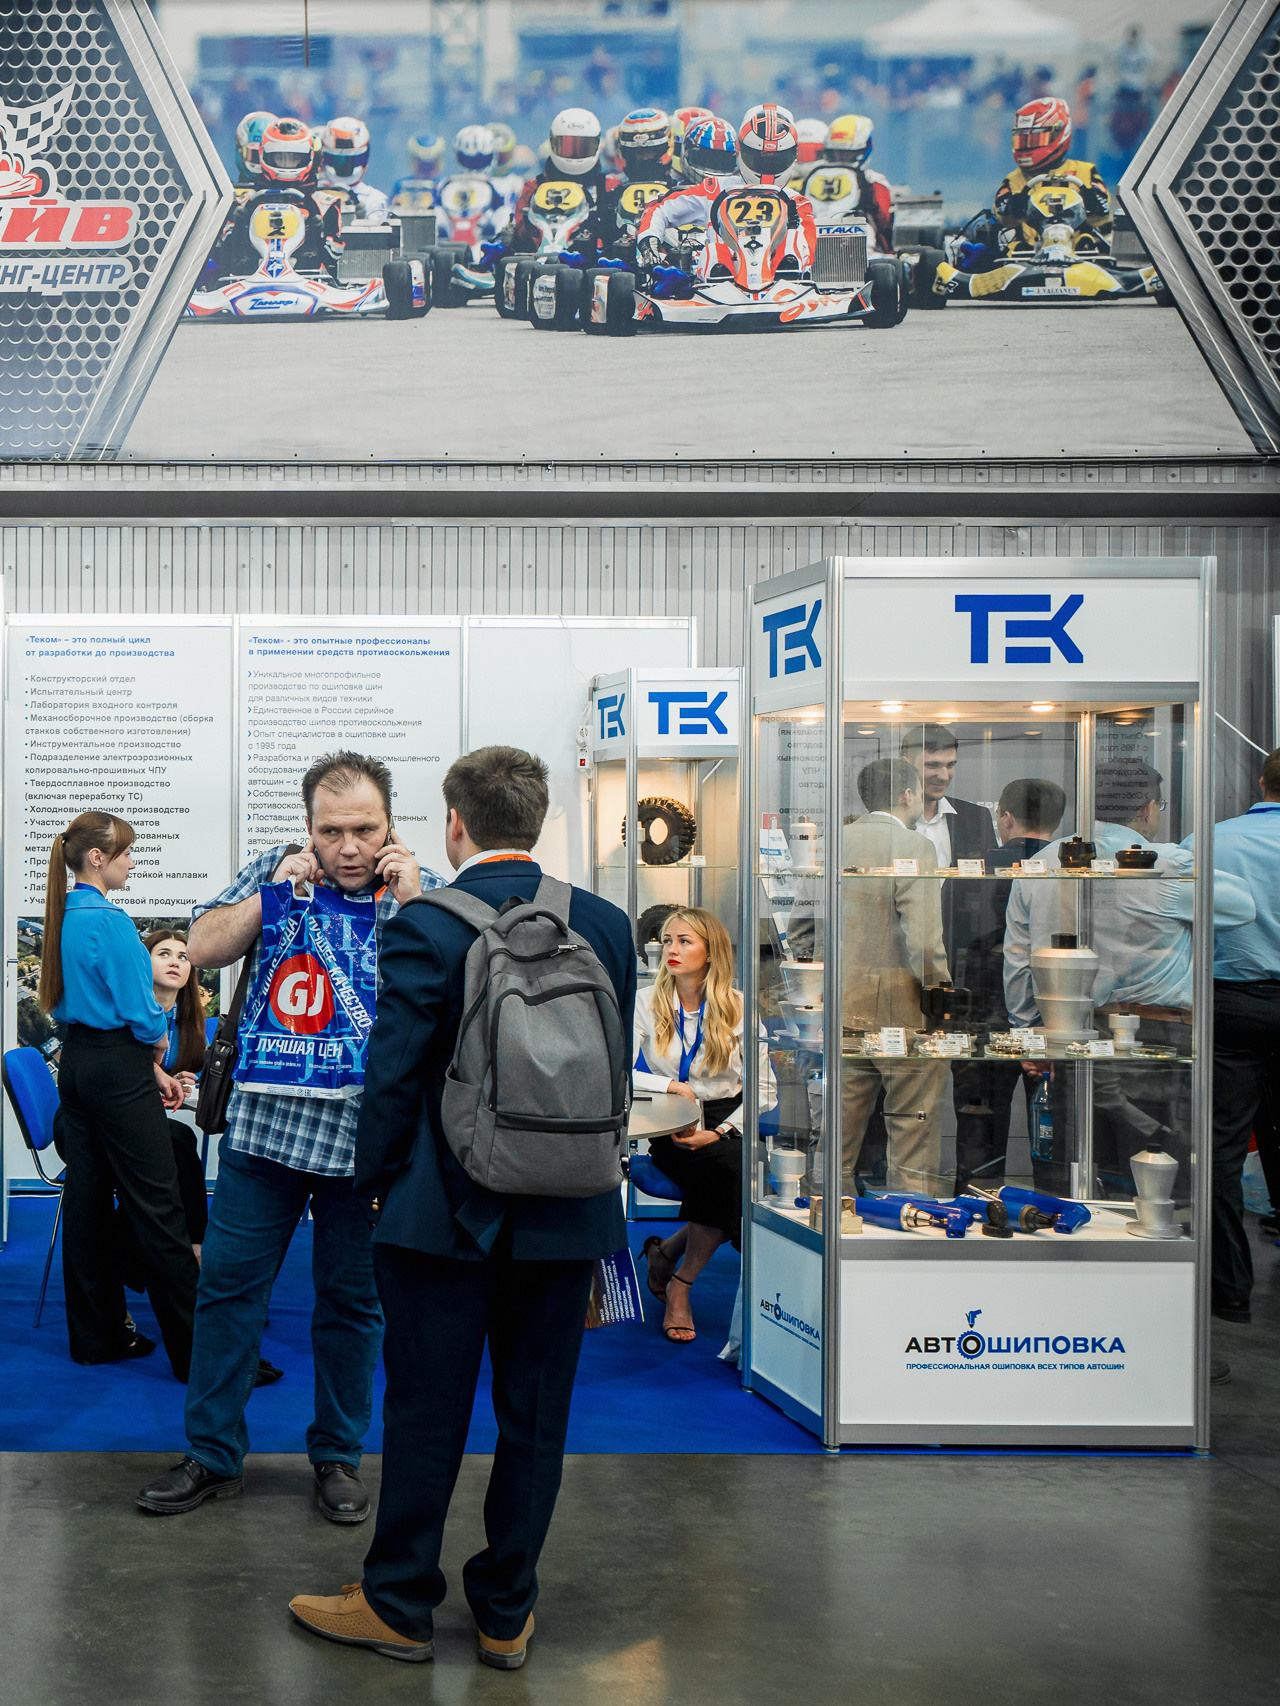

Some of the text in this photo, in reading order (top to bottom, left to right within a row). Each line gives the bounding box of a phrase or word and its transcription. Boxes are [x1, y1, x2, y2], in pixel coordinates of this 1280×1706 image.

[734, 201, 774, 223] 23
[819, 226, 865, 235] ITAKA
[26, 635, 61, 643] «Теком»
[249, 636, 283, 644] «Теком»
[356, 637, 430, 645] профессионалы
[39, 648, 92, 657] разработки
[31, 674, 107, 684] Конструкторский
[252, 670, 380, 679] Уникальное многопрофильное
[31, 687, 132, 697] Испытательный центр
[249, 683, 308, 691] производство
[266, 695, 310, 703] различных
[313, 695, 337, 703] видов
[30, 700, 89, 710] Лаборатория
[137, 702, 177, 710] контроля
[252, 705, 394, 715] Единственное России серийное
[31, 713, 213, 723] Механосборочное производство (сборка
[339, 719, 422, 727] противоскольжения
[63, 726, 124, 734] собственного
[127, 727, 190, 736] изготовления)
[253, 729, 275, 737] Опыт
[31, 739, 181, 749] Инструментальное производство
[257, 741, 275, 749] 1995
[31, 752, 192, 762] Подразделение электроэрозионных
[253, 753, 303, 762] Разработка
[25, 766, 166, 775] копировально-прошивных ЧПУ
[248, 766, 307, 774] оборудования
[30, 778, 170, 788] Твердосплавное производство
[25, 792, 142, 801] (включая переработку ТС)
[253, 813, 299, 822] Поставщик
[255, 824, 307, 834] зарубежных
[111, 897, 198, 907] готовой продукции
[309, 916, 336, 962] ЛУЧШЕЕ
[329, 967, 373, 1028] КАЧЕСТВО
[278, 971, 324, 1016] GJ
[255, 1038, 343, 1059] ЛУЧШАЯ ЦЕН
[905, 1332, 1126, 1358] АВТОШИПОВКА
